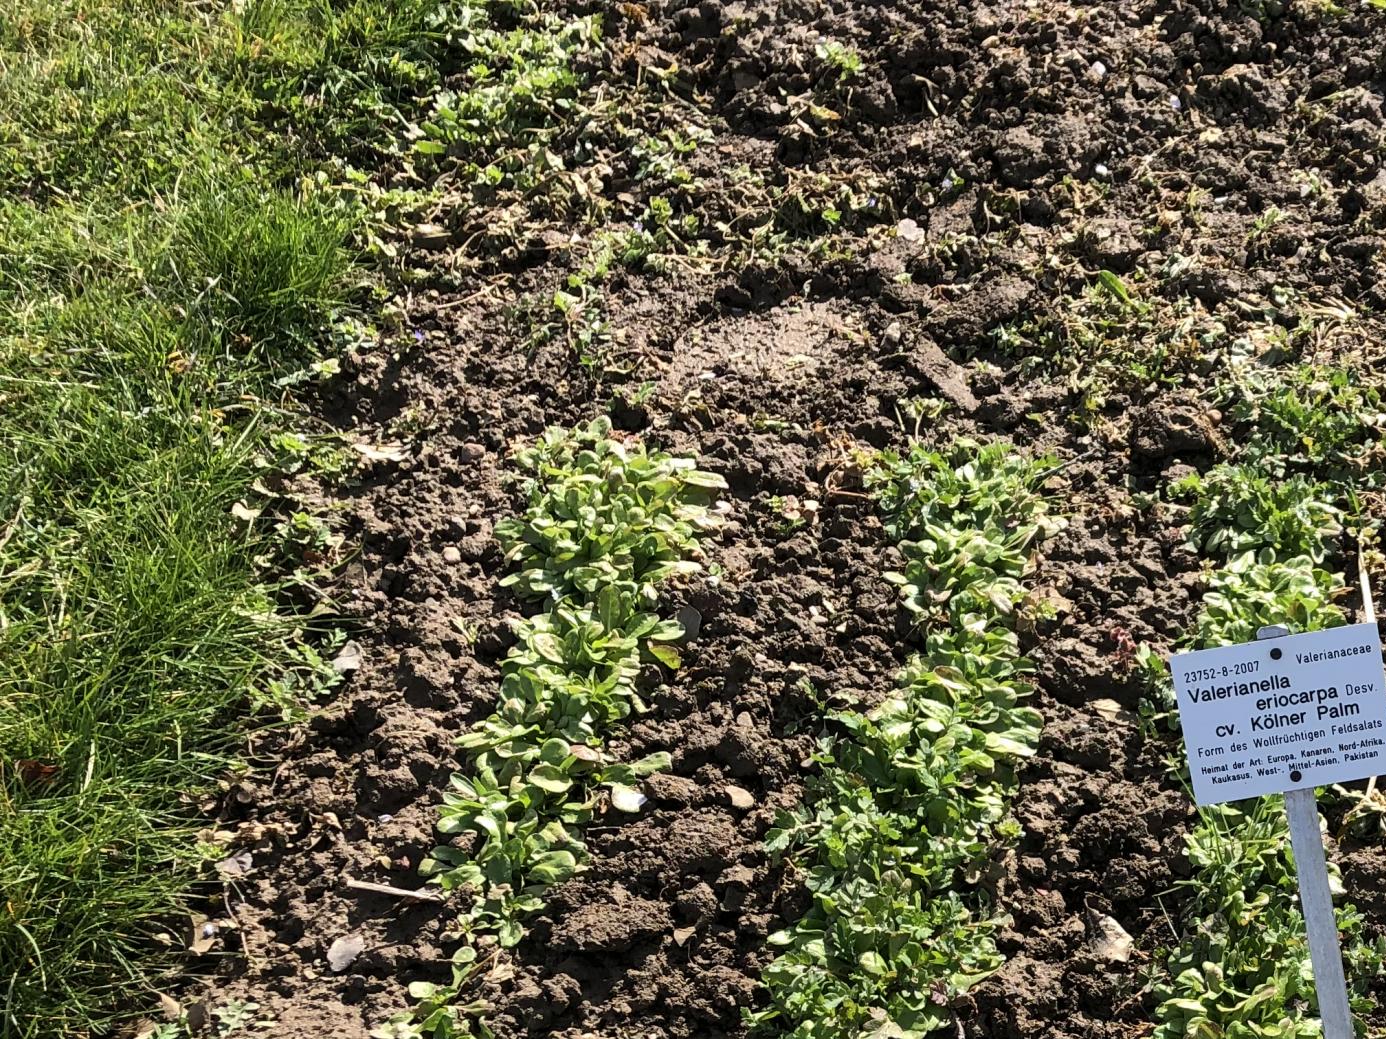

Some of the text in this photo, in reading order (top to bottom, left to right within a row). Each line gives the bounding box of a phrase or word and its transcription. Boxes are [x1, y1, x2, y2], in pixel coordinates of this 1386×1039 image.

[1184, 644, 1371, 683] 23752-8-2007 Valerianaceae
[1188, 675, 1291, 703] Valerianella
[1257, 683, 1377, 710] eriocarpa Desv.
[1216, 704, 1359, 737] cv. Kölner Palm
[1198, 719, 1382, 757] Form des Wollfrüchtigen Feldsalats
[1201, 764, 1228, 774] Heimat
[1233, 761, 1245, 770] der
[1250, 757, 1263, 766] Art:
[1345, 750, 1378, 762] Pakistan
